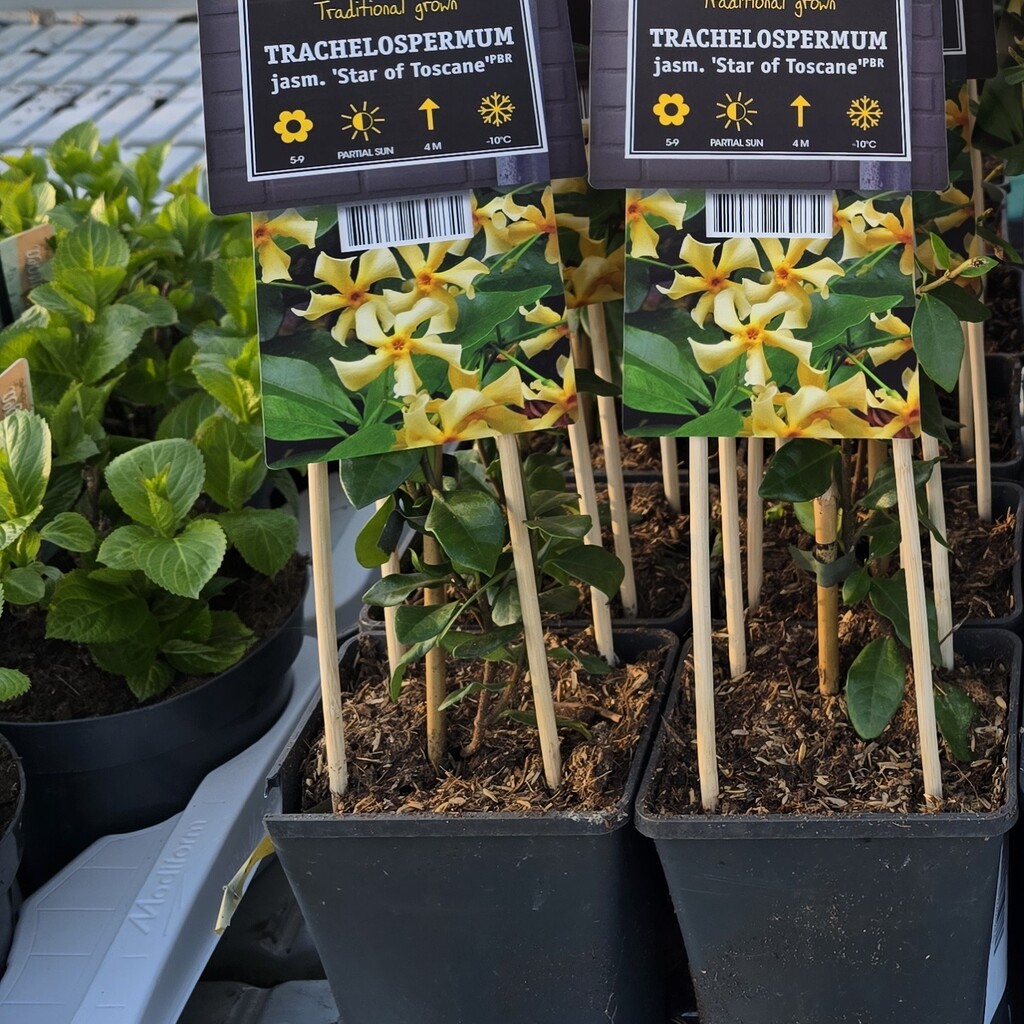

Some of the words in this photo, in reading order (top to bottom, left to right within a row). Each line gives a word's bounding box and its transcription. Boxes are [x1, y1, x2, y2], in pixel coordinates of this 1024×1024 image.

[794, 0, 836, 18] grown
[264, 27, 515, 65] TRACHELOSPERMUM
[649, 28, 888, 50] TRACHELOSPERMUM
[653, 56, 705, 77] jasm.
[712, 57, 754, 74] 'Star
[760, 58, 780, 74] of
[271, 73, 326, 95] jasm.
[332, 66, 377, 85] 'Star
[384, 63, 404, 80] of
[665, 138, 679, 147] 5-9
[710, 138, 743, 147] PARTIAL
[745, 138, 764, 147] SUN
[290, 155, 305, 164] 5-9
[337, 148, 373, 159] PARTIAL
[374, 146, 394, 156] SUN
